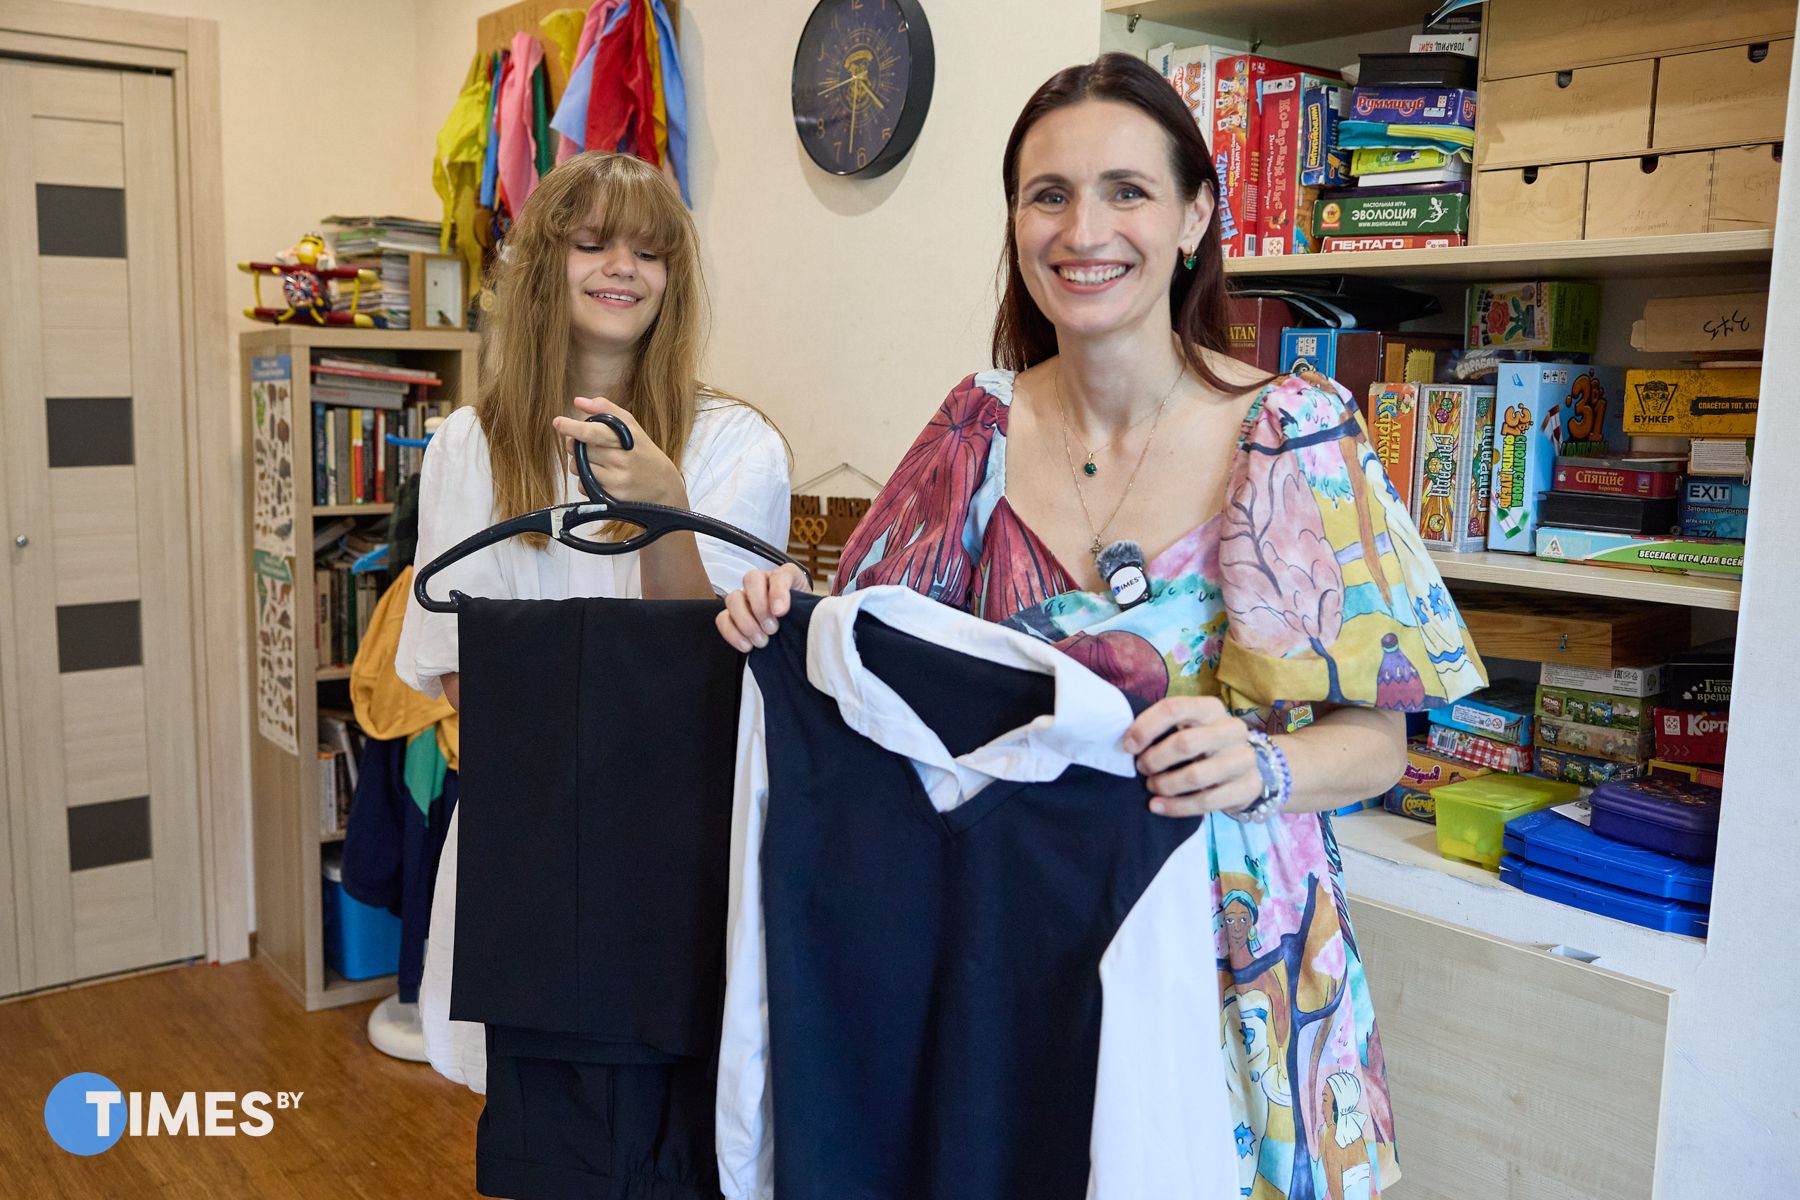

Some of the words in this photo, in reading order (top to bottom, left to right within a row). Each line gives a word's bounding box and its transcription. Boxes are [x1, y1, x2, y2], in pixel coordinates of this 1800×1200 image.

[1216, 148, 1239, 240] HEDBANZ
[1352, 208, 1417, 221] ЭВОЛЮЦИЯ
[1331, 238, 1404, 250] ПЕНТАГО
[1634, 415, 1675, 424] БУНКЕР
[1502, 435, 1515, 473] ФАНТЫ
[1511, 442, 1527, 508] ПОЛУСЛОВА
[1575, 471, 1624, 486] Спящие
[1500, 473, 1514, 508] ДУБЛЬ
[1690, 485, 1729, 502] EXIT
[1639, 550, 1677, 562] ВЕСЕЛАЯ
[1678, 552, 1699, 563] ИГРА
[1700, 554, 1719, 566] ДЛЯ
[1721, 556, 1744, 568] ВСЕЙ
[1697, 693, 1731, 703] вреди
